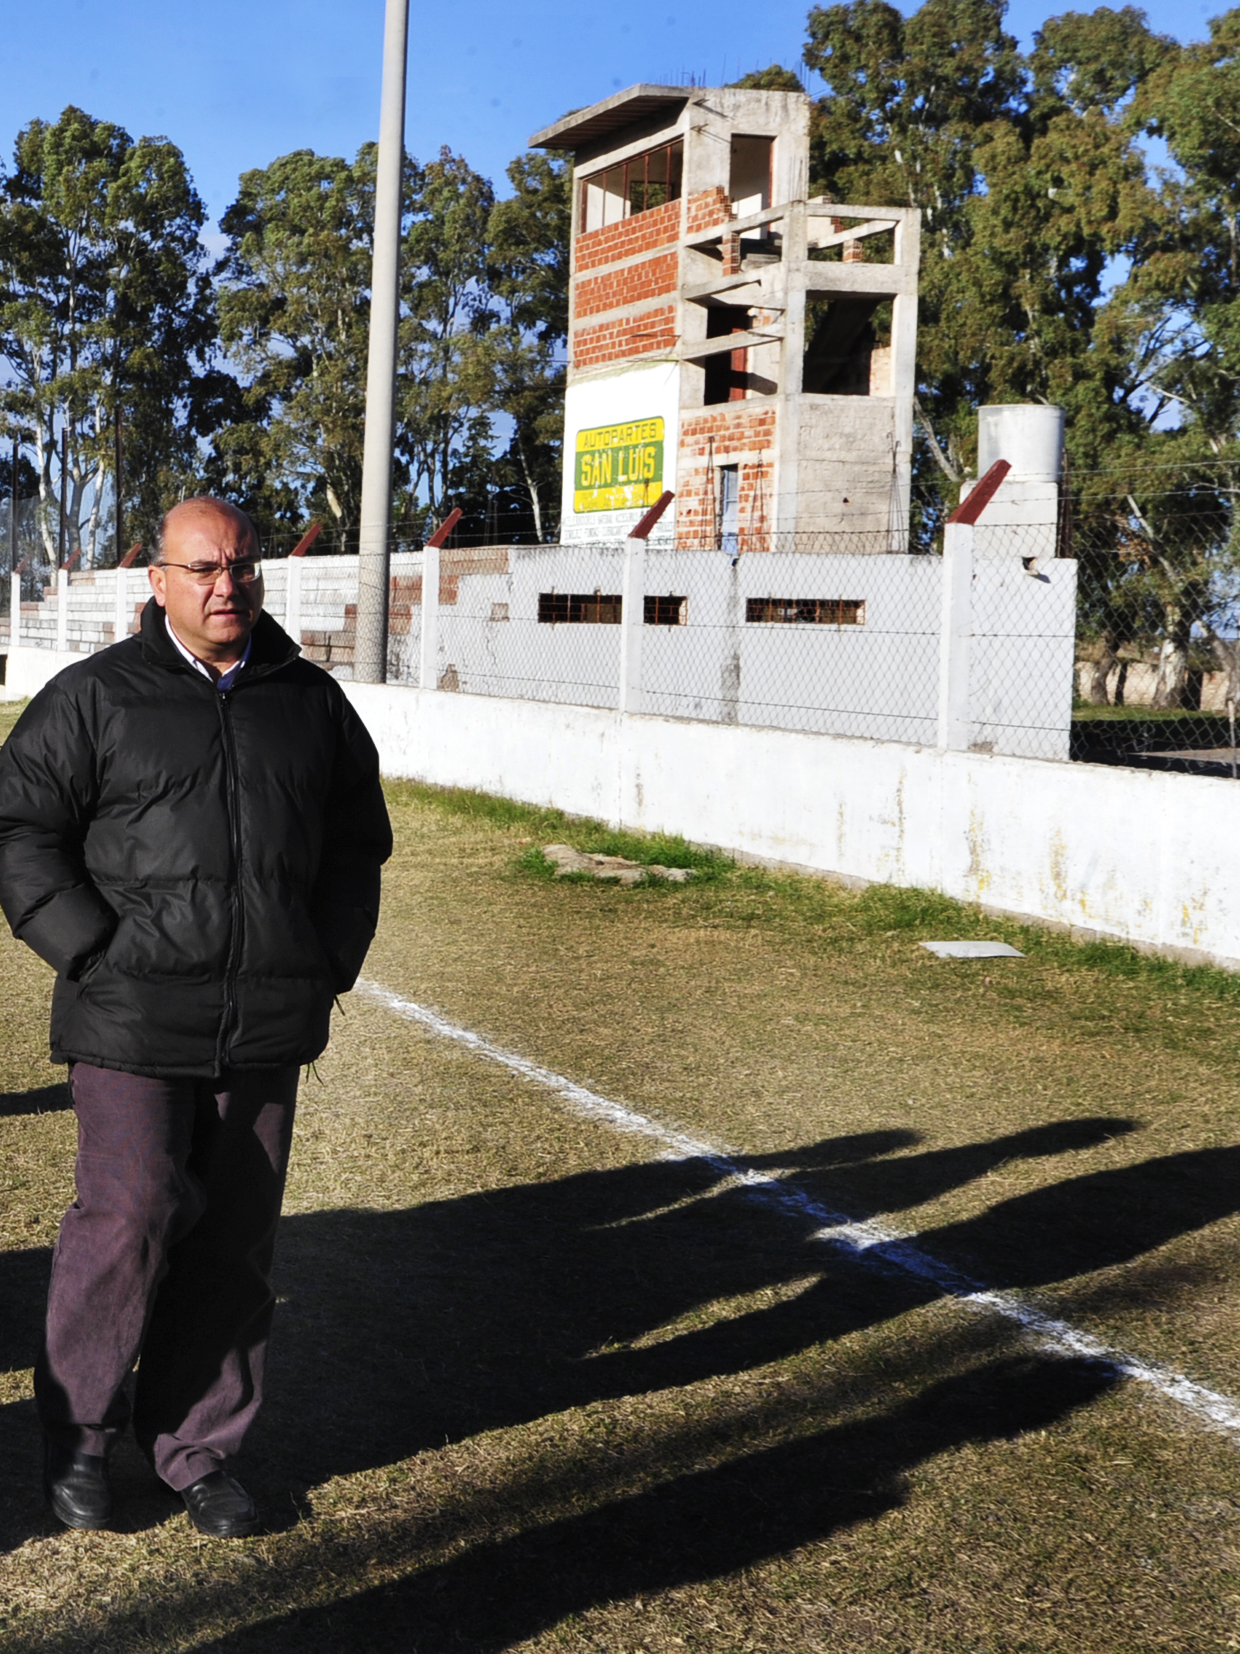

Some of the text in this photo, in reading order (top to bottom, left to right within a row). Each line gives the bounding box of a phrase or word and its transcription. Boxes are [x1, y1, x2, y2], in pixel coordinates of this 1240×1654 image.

[583, 422, 657, 448] AUTOPARTES
[581, 446, 655, 486] SAN LUIS
